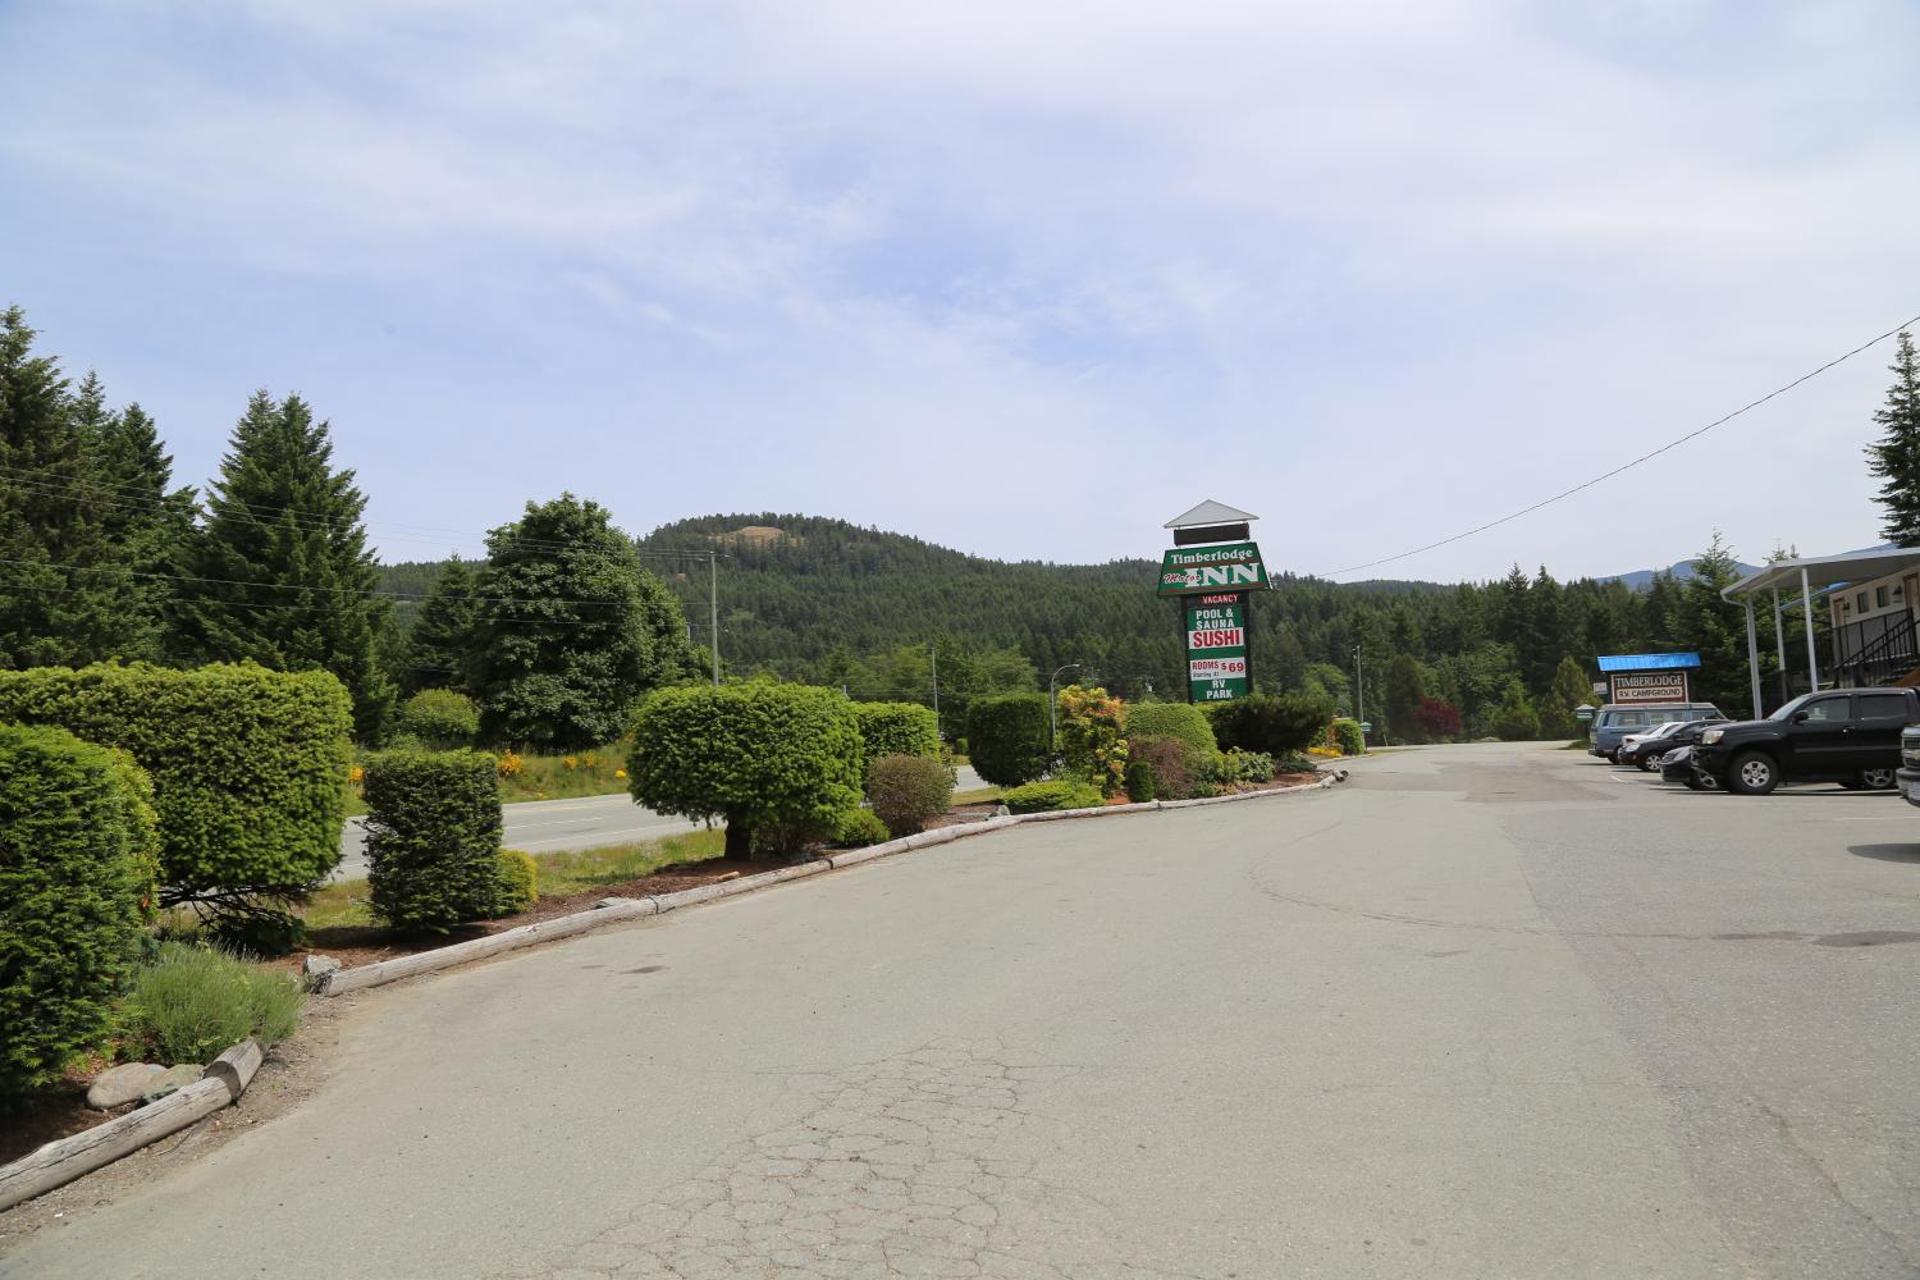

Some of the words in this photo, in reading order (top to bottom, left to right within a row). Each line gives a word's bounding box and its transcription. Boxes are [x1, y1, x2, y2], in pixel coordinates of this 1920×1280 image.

[1171, 549, 1253, 564] Timberlodge
[1183, 562, 1260, 587] INN
[1203, 594, 1238, 604] VACANCY
[1196, 609, 1222, 620] POOL
[1226, 608, 1234, 618] &
[1196, 619, 1235, 630] SAUNA
[1193, 629, 1240, 648] SUSHI
[1192, 661, 1219, 670] ROOMS
[1212, 679, 1226, 689] RV
[1615, 675, 1683, 687] TIMBERLODGE
[1206, 689, 1233, 699] PARK
[1631, 688, 1681, 697] CAMPGROUND
